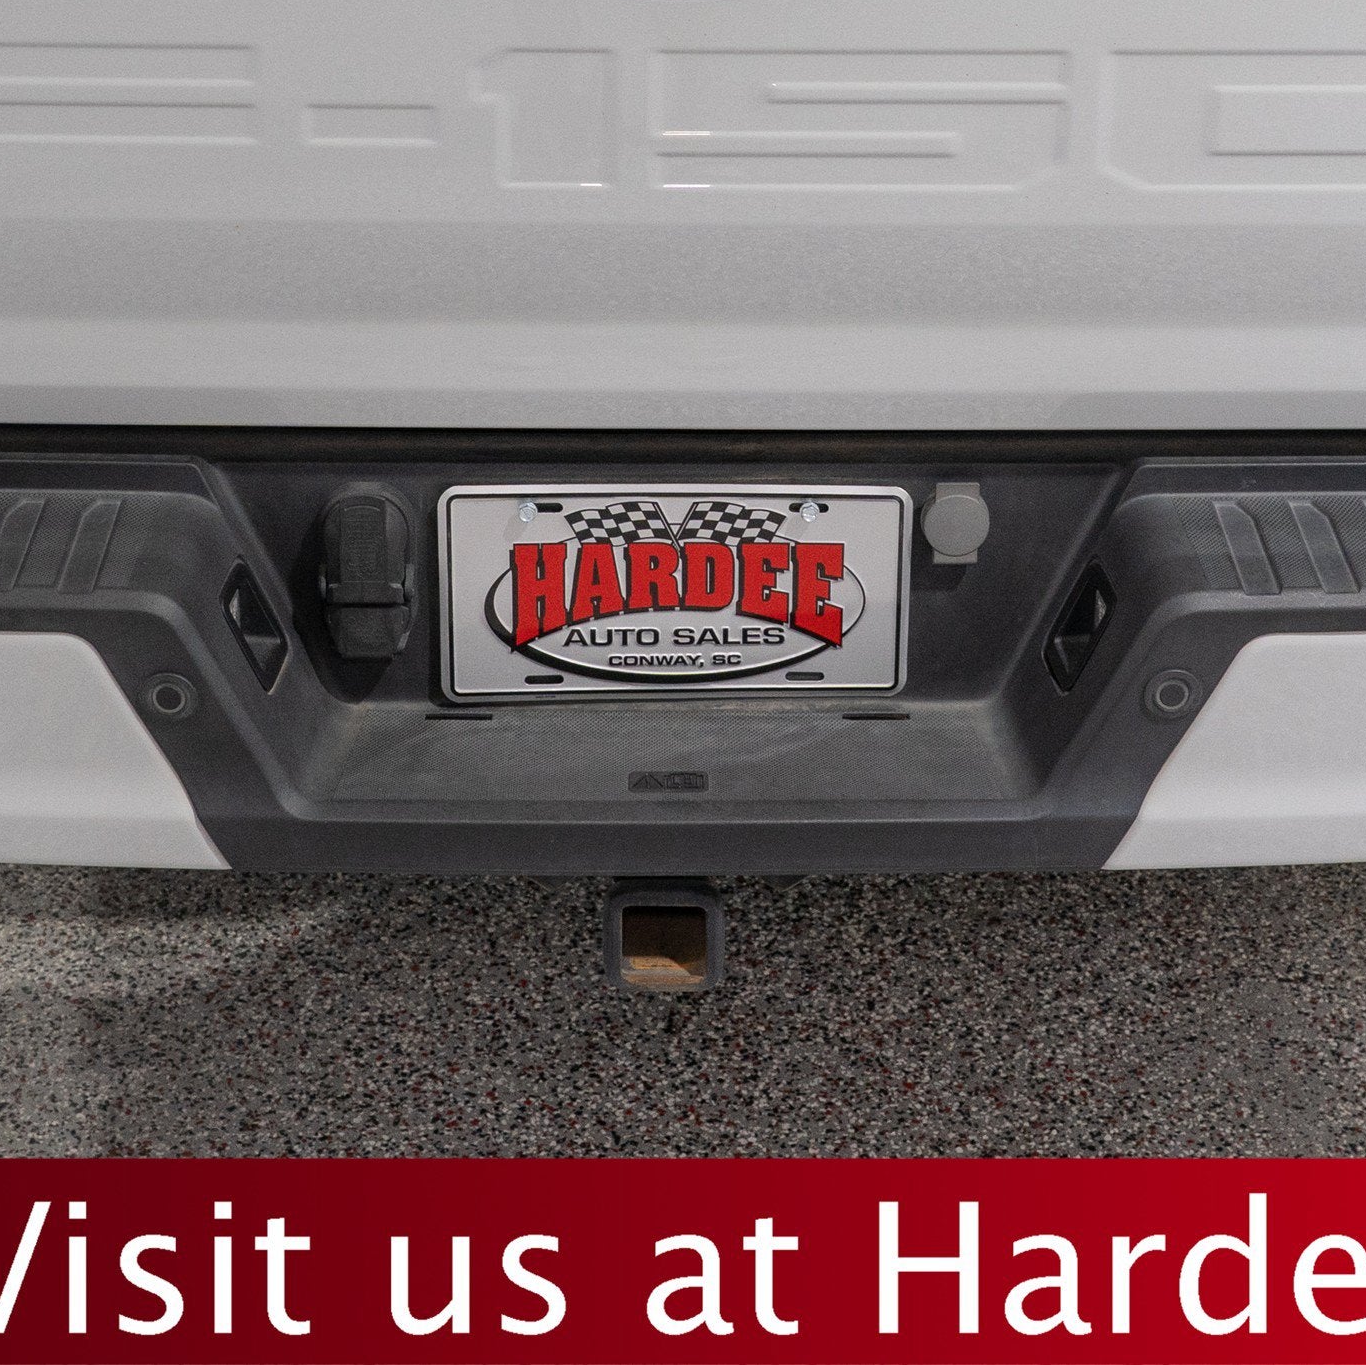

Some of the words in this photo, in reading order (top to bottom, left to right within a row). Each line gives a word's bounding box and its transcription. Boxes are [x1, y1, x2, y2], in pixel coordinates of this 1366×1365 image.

[509, 541, 844, 653] HARDEE
[563, 627, 661, 647] AUTO
[672, 626, 786, 646] SALES
[608, 652, 705, 669] CONWAY,
[712, 652, 742, 666] SC
